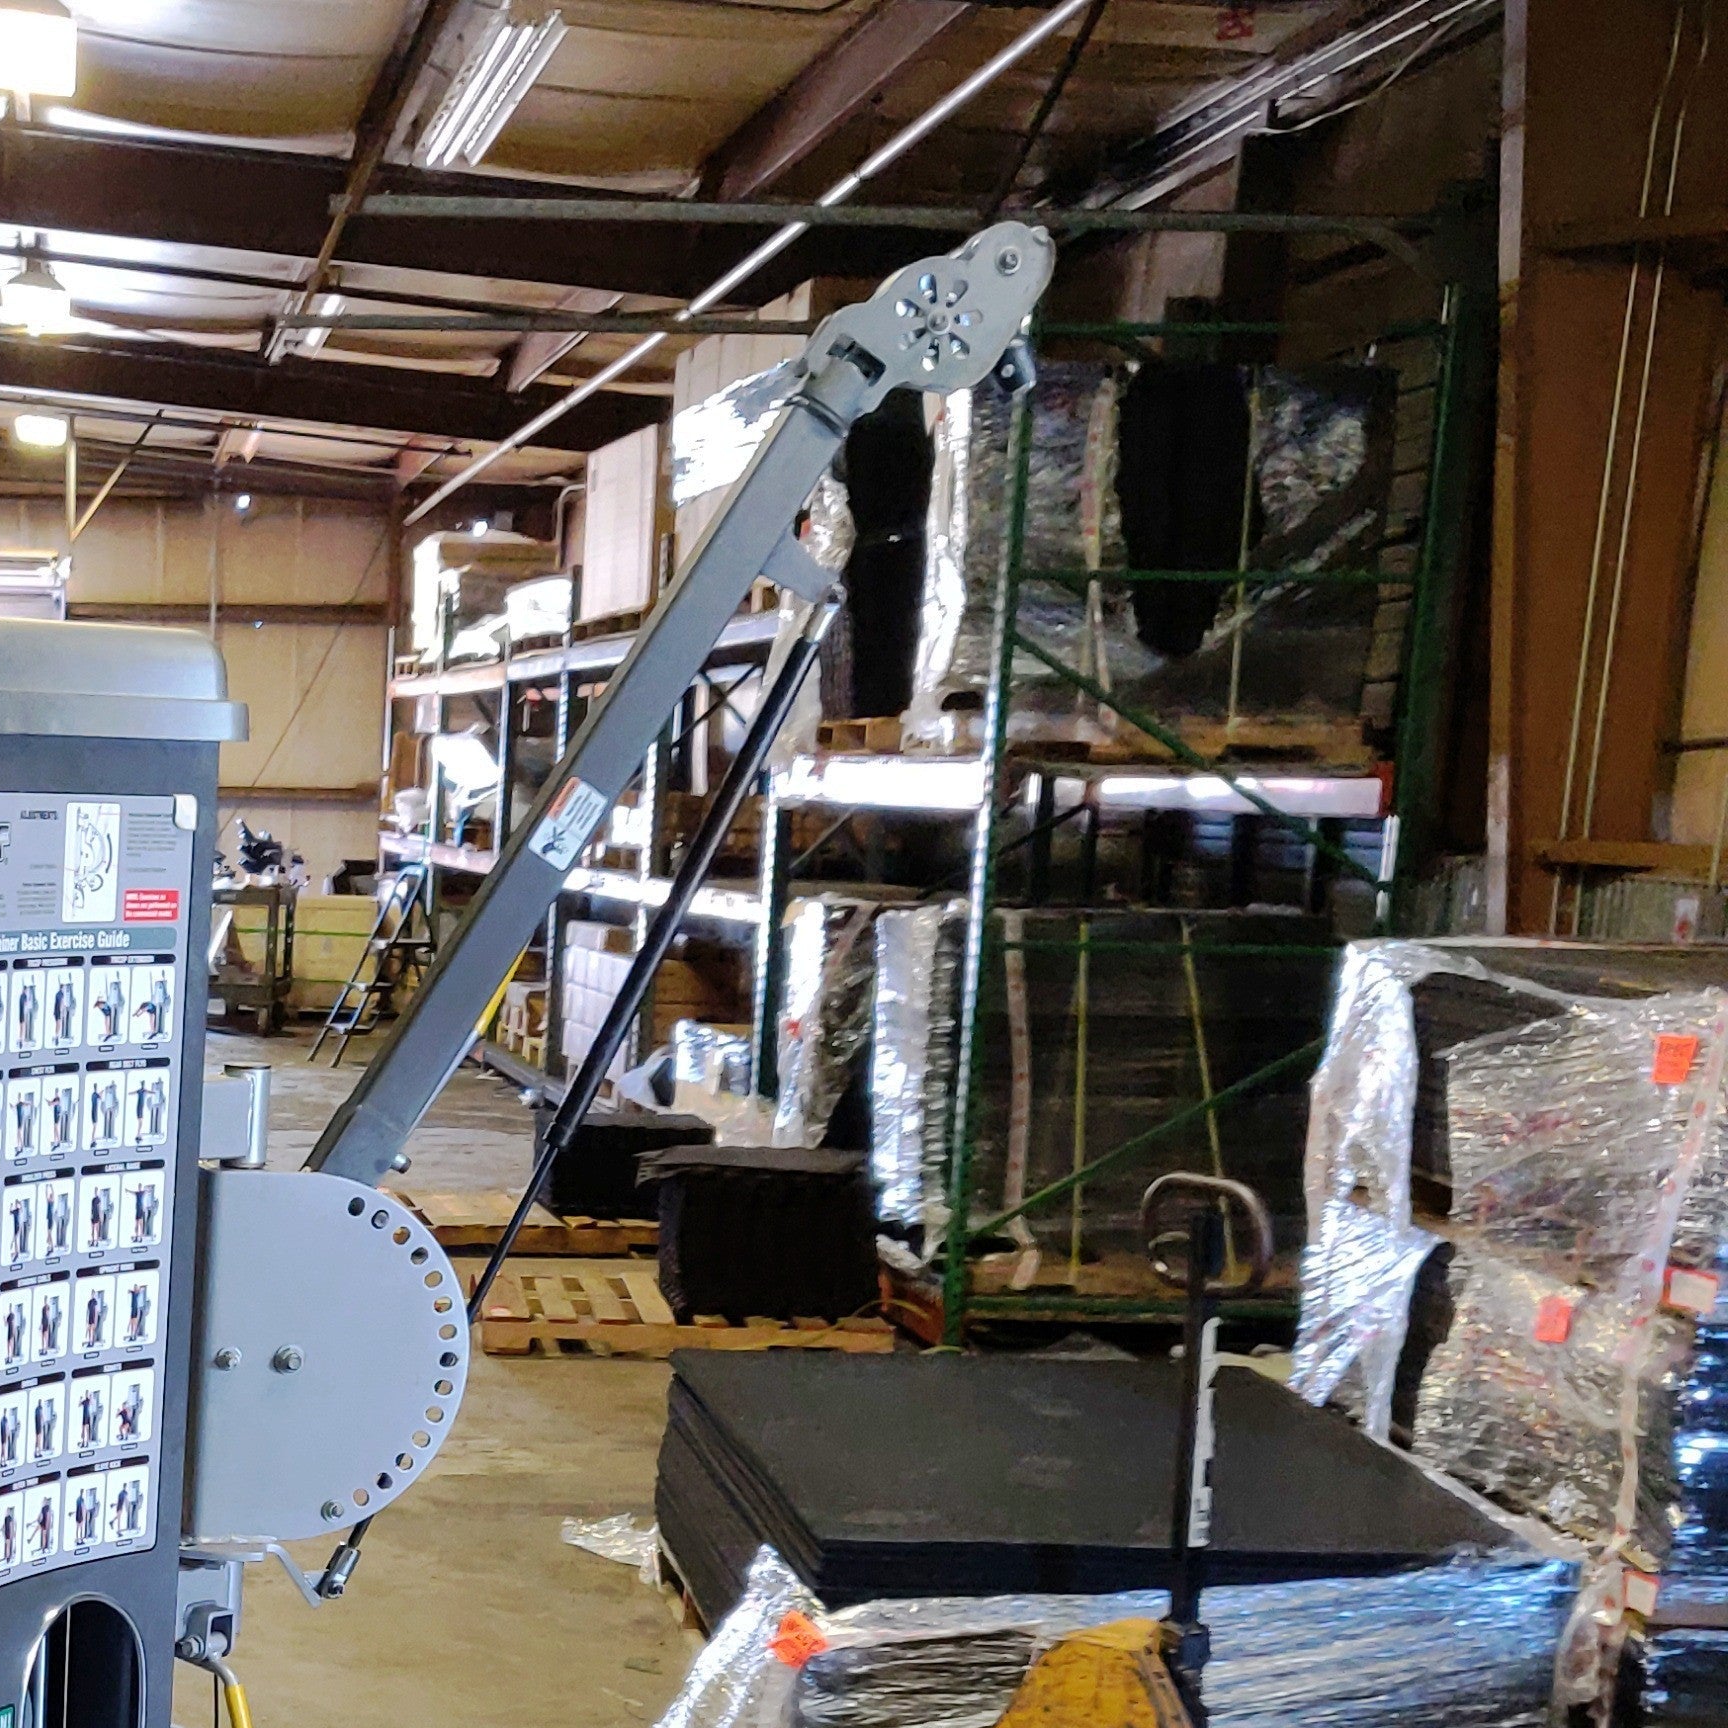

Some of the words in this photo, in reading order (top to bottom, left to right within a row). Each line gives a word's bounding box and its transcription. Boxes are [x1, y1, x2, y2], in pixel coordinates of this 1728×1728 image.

[21, 931, 48, 951] Basic
[50, 931, 95, 950] Exercise
[97, 929, 130, 948] Guide
